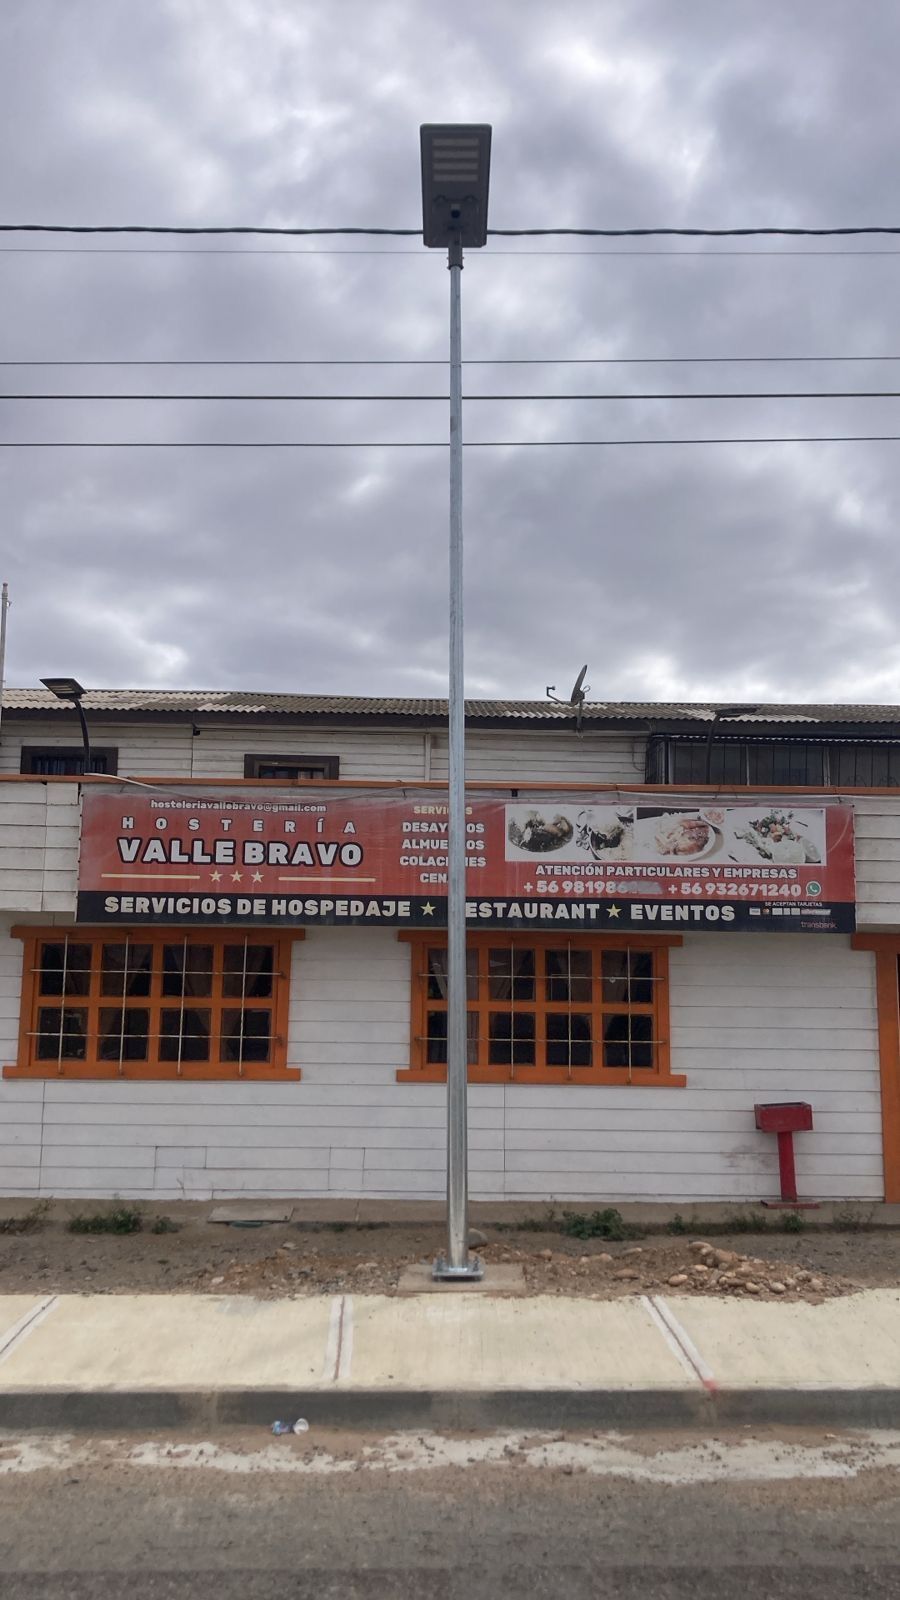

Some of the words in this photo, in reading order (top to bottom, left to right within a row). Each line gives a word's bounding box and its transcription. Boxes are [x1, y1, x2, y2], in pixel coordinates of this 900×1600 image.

[150, 799, 327, 813] hosteleriavallebravo@gmail.com
[413, 805, 473, 815] SERVIS
[122, 816, 356, 833] HOSTERÍA
[402, 822, 485, 833] DESAYOS
[402, 839, 485, 850] ALMUEOS
[117, 837, 236, 865] VALLE
[242, 840, 363, 868] BRAVO
[400, 856, 486, 868] COLACIES
[535, 862, 604, 876] ATENCIÓN
[606, 866, 710, 878] PARTICULARES
[712, 867, 720, 878] Y
[723, 868, 798, 879] EMPRESAS
[705, 883, 802, 897] 932671240
[104, 896, 232, 915] SERVICIOS
[236, 899, 266, 915] DE
[271, 899, 411, 918] HOSPEDAJE
[464, 902, 600, 919] ESTAURANT
[630, 903, 736, 922] EVENTOS
